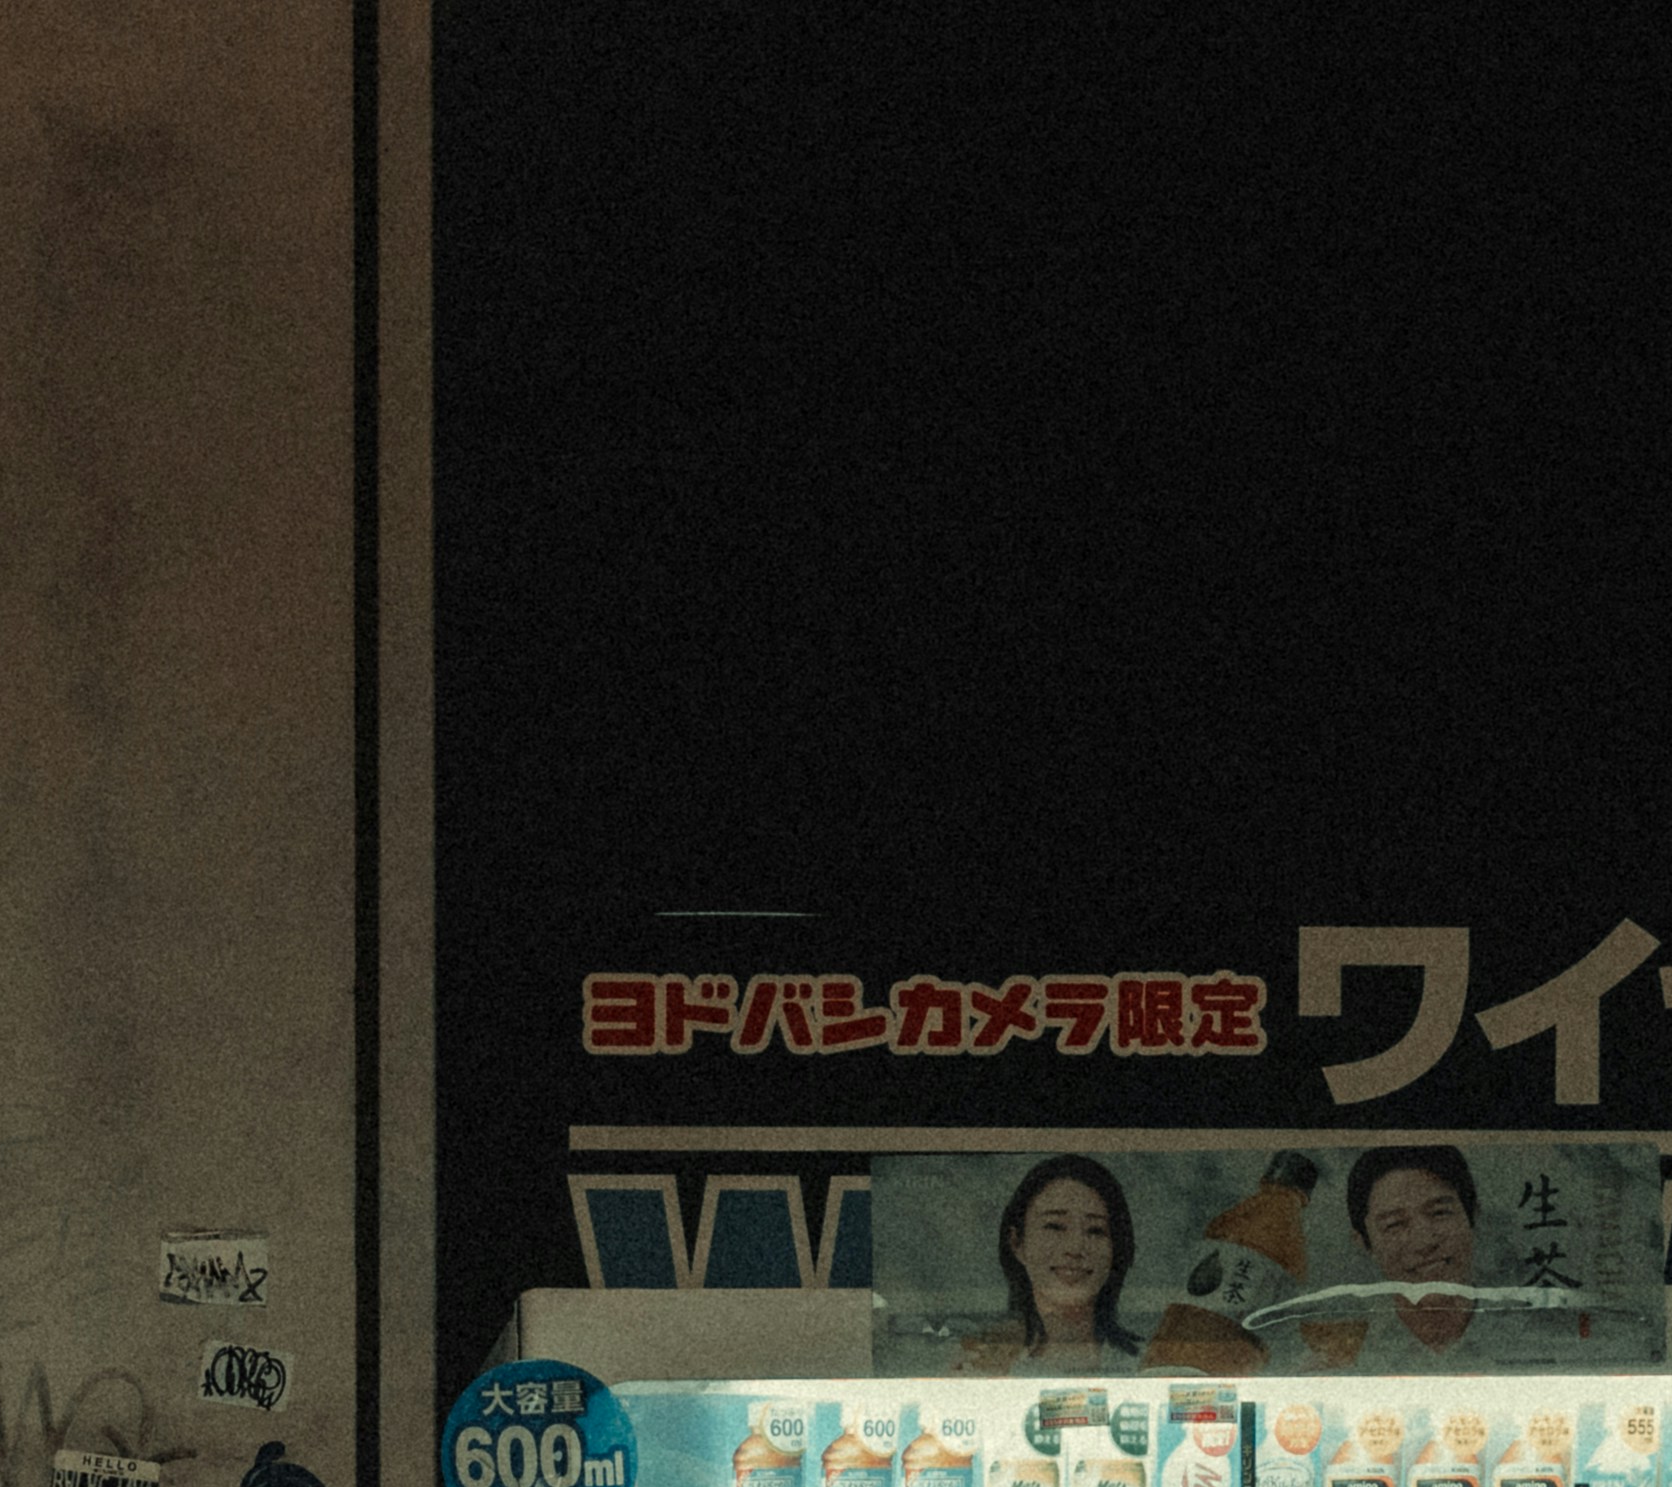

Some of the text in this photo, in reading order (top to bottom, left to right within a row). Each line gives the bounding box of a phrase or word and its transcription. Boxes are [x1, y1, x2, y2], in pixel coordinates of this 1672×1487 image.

[582, 973, 1269, 1058] ヨドバシカメラ限定
[481, 1379, 586, 1418] 大容量
[82, 1455, 138, 1472] HELLO
